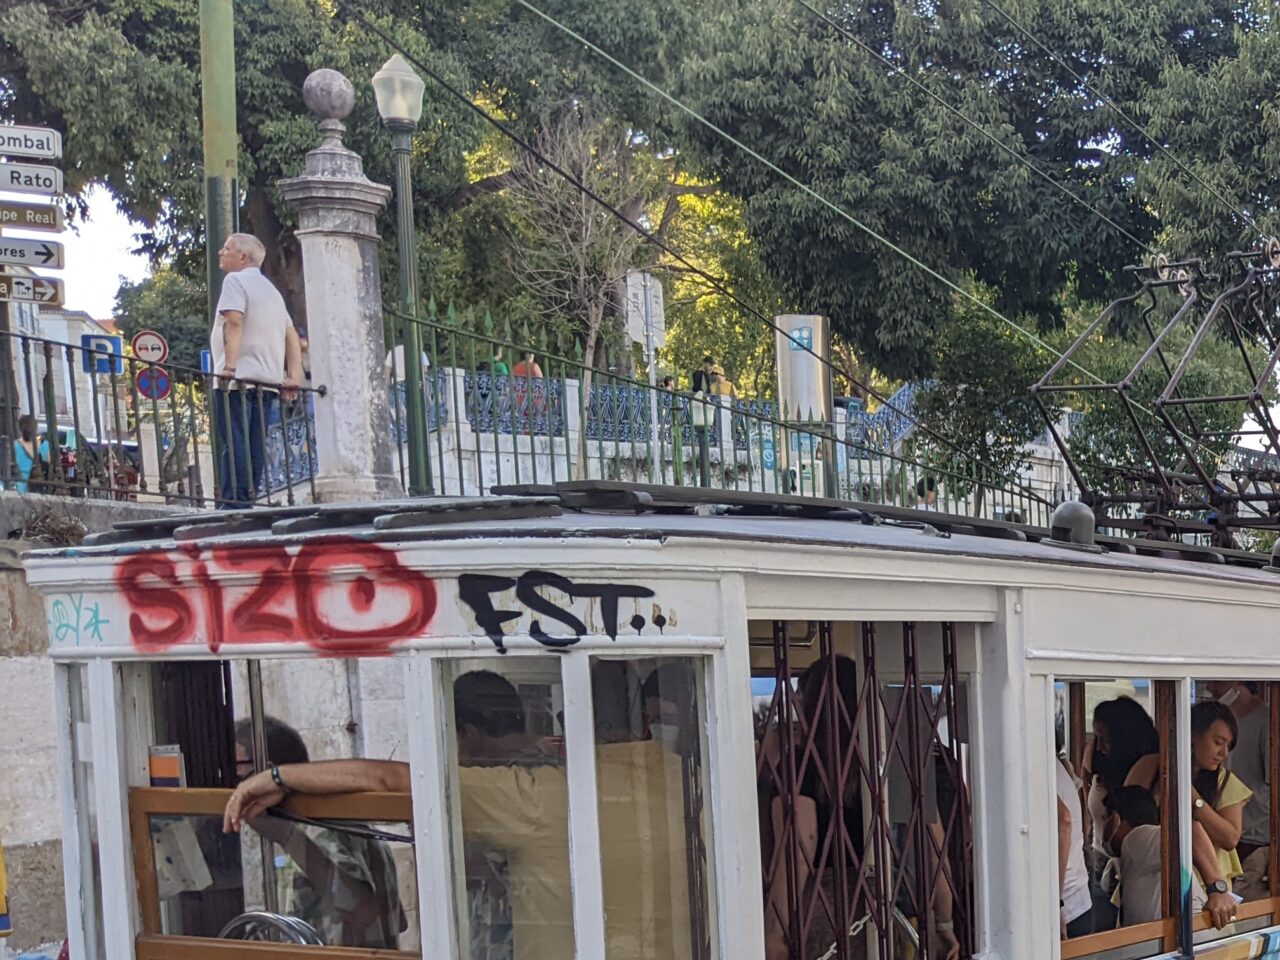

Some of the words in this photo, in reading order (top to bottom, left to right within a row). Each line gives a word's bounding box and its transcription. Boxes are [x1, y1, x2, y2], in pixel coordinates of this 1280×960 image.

[10, 170, 53, 188] Rato
[26, 209, 55, 224] Real
[90, 338, 114, 371] P
